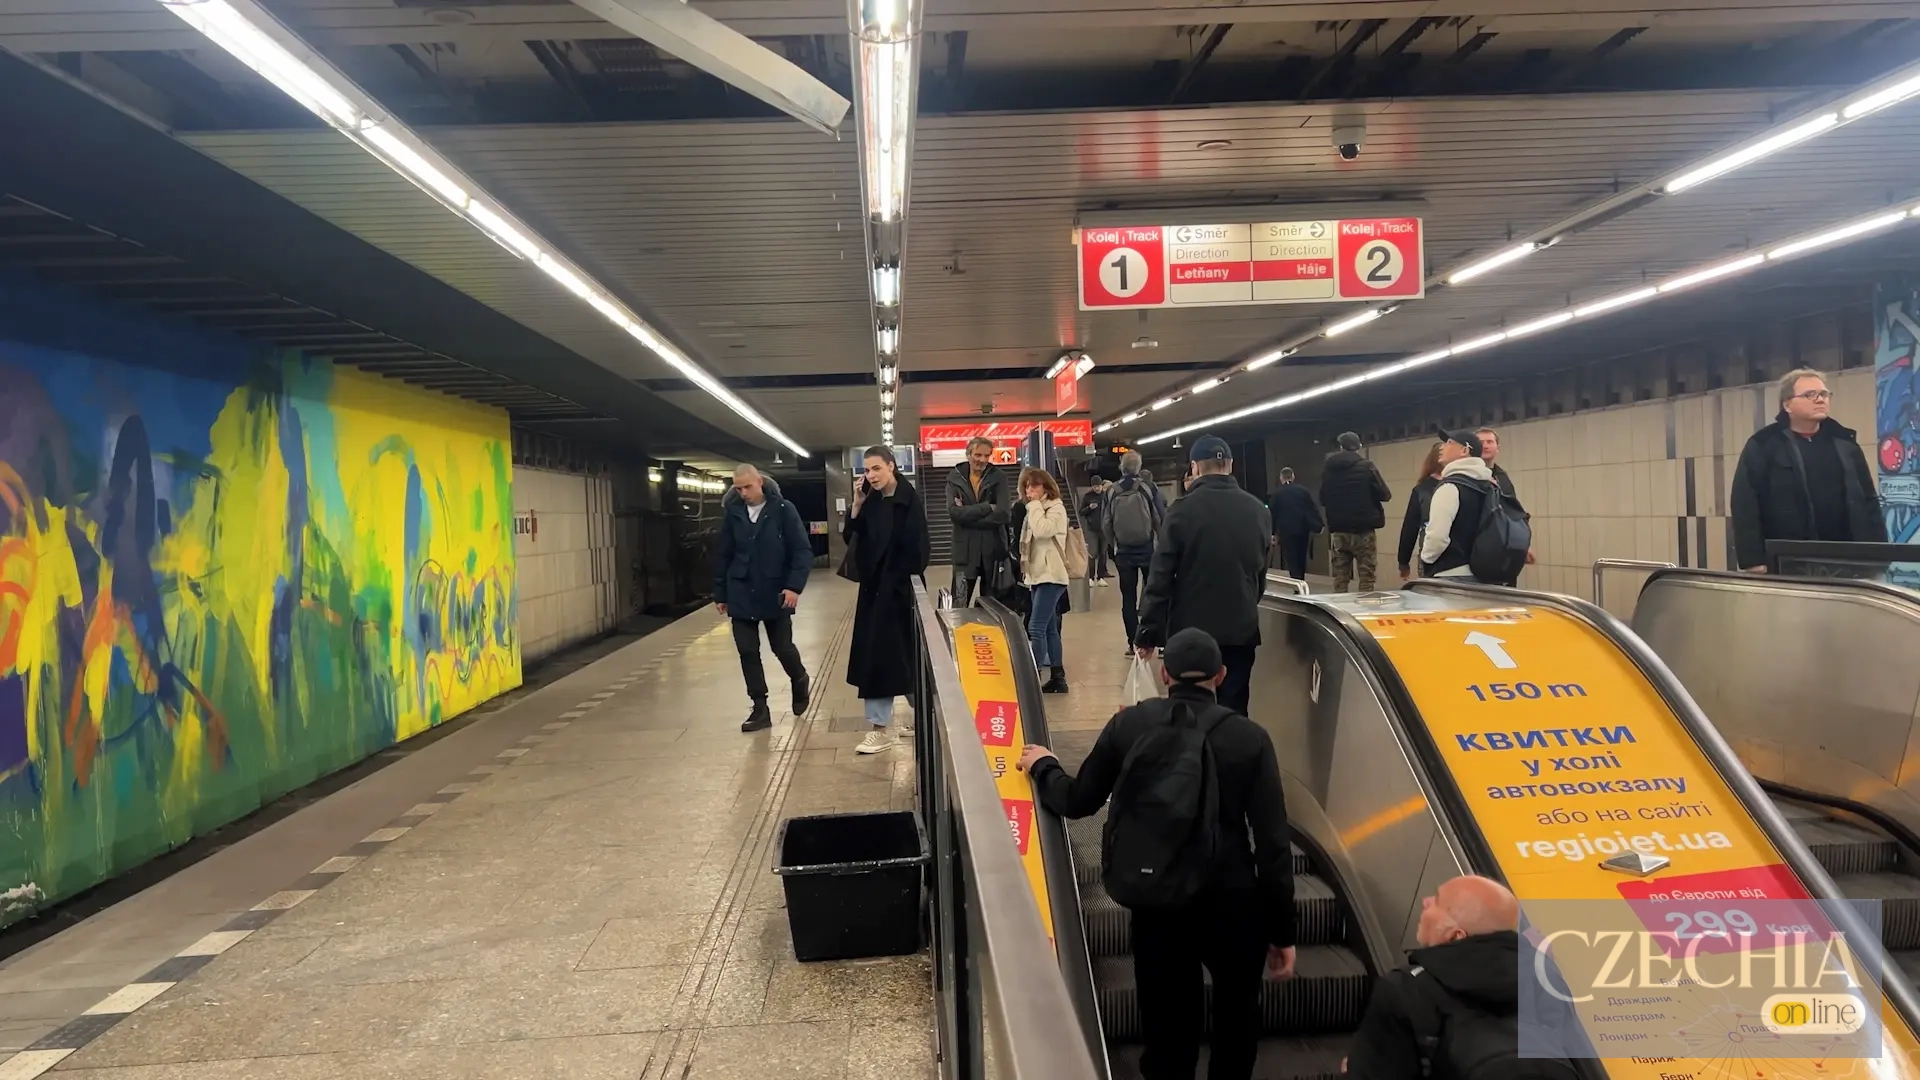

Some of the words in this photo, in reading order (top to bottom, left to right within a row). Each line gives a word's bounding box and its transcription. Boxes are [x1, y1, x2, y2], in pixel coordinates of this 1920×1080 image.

[1087, 230, 1119, 244] Kolej
[1126, 230, 1159, 242] Track
[1195, 227, 1228, 239] Směr
[1270, 224, 1303, 237] Směr
[1342, 222, 1375, 237] Kolej
[1381, 222, 1414, 234] Track
[1176, 246, 1229, 259] Direction
[1270, 243, 1327, 256] Direction
[1297, 263, 1327, 276] Háje
[1366, 246, 1392, 282] 2
[1111, 254, 1128, 290] 1
[1176, 266, 1230, 280] Letňany
[1465, 681, 1542, 701] 150
[990, 717, 1006, 739] 499
[1455, 725, 1637, 752] КВИТКИ
[1520, 759, 1540, 777] у
[1548, 750, 1622, 771] холі
[1486, 776, 1687, 799] автовокзалу
[1536, 807, 1589, 825] або
[1595, 808, 1631, 822] на
[1637, 800, 1713, 820] сайті
[1649, 893, 1669, 904] до
[1671, 889, 1737, 903] Європи
[1739, 887, 1768, 899] від
[1665, 909, 1759, 939] 299
[1765, 922, 1815, 937] Крон
[1593, 1012, 1666, 1023] Амстердам
[1599, 1032, 1648, 1042] Лондон
[1631, 1055, 1677, 1065] Париж
